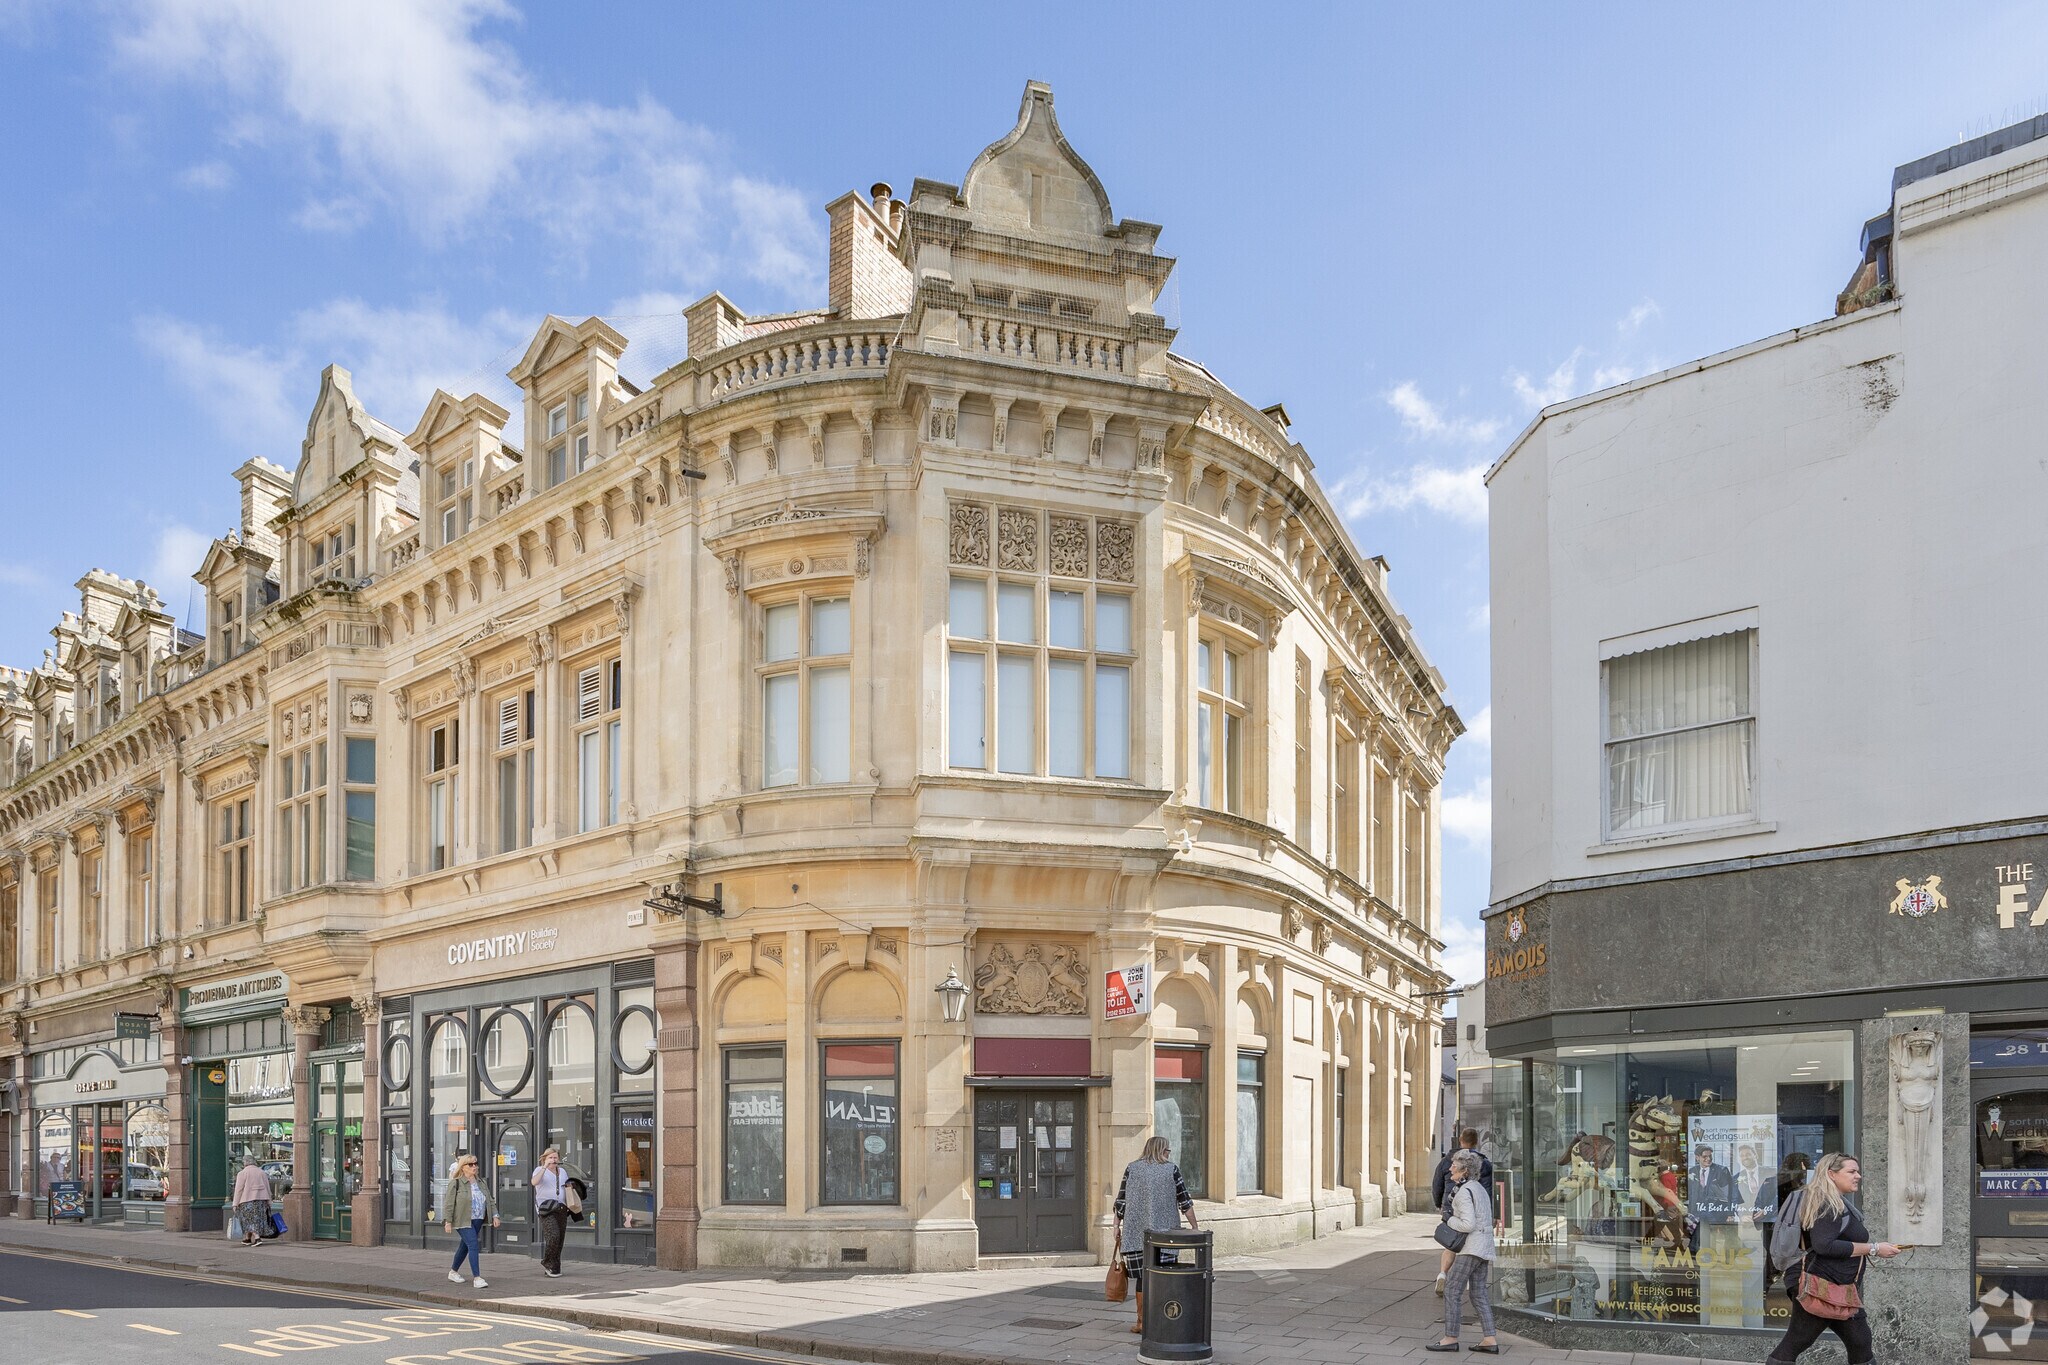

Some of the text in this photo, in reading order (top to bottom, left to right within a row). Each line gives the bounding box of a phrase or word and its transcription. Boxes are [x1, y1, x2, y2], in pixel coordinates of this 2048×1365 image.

[1994, 862, 2034, 884] THE
[530, 926, 558, 940] Building
[447, 931, 528, 966] COVENTRY
[530, 939, 556, 951] Society
[1487, 943, 1546, 980] FAMOUS
[1128, 967, 1143, 975] JOHN
[1128, 974, 1143, 982] RYDE
[188, 975, 283, 1006] PROMENADE ANTIQUES
[1107, 997, 1126, 1008] TO LET
[2005, 1044, 2029, 1055] 28
[74, 1079, 114, 1093] ROSA'S THAI
[2009, 1117, 2031, 1126] sort
[1705, 1126, 1729, 1135] sort my
[1986, 1179, 2018, 1190] MARC
[1696, 1202, 1707, 1212] The
[1708, 1202, 1723, 1212] Best
[1730, 1202, 1747, 1212] Man
[1763, 1204, 1774, 1216] get
[1641, 1236, 1655, 1246] THE
[1640, 1246, 1754, 1271] FAMOUS
[1685, 1270, 1701, 1280] ON
[1632, 1285, 1674, 1297] KEEPING
[1676, 1286, 1693, 1298] THE
[248, 1315, 493, 1352] STOP
